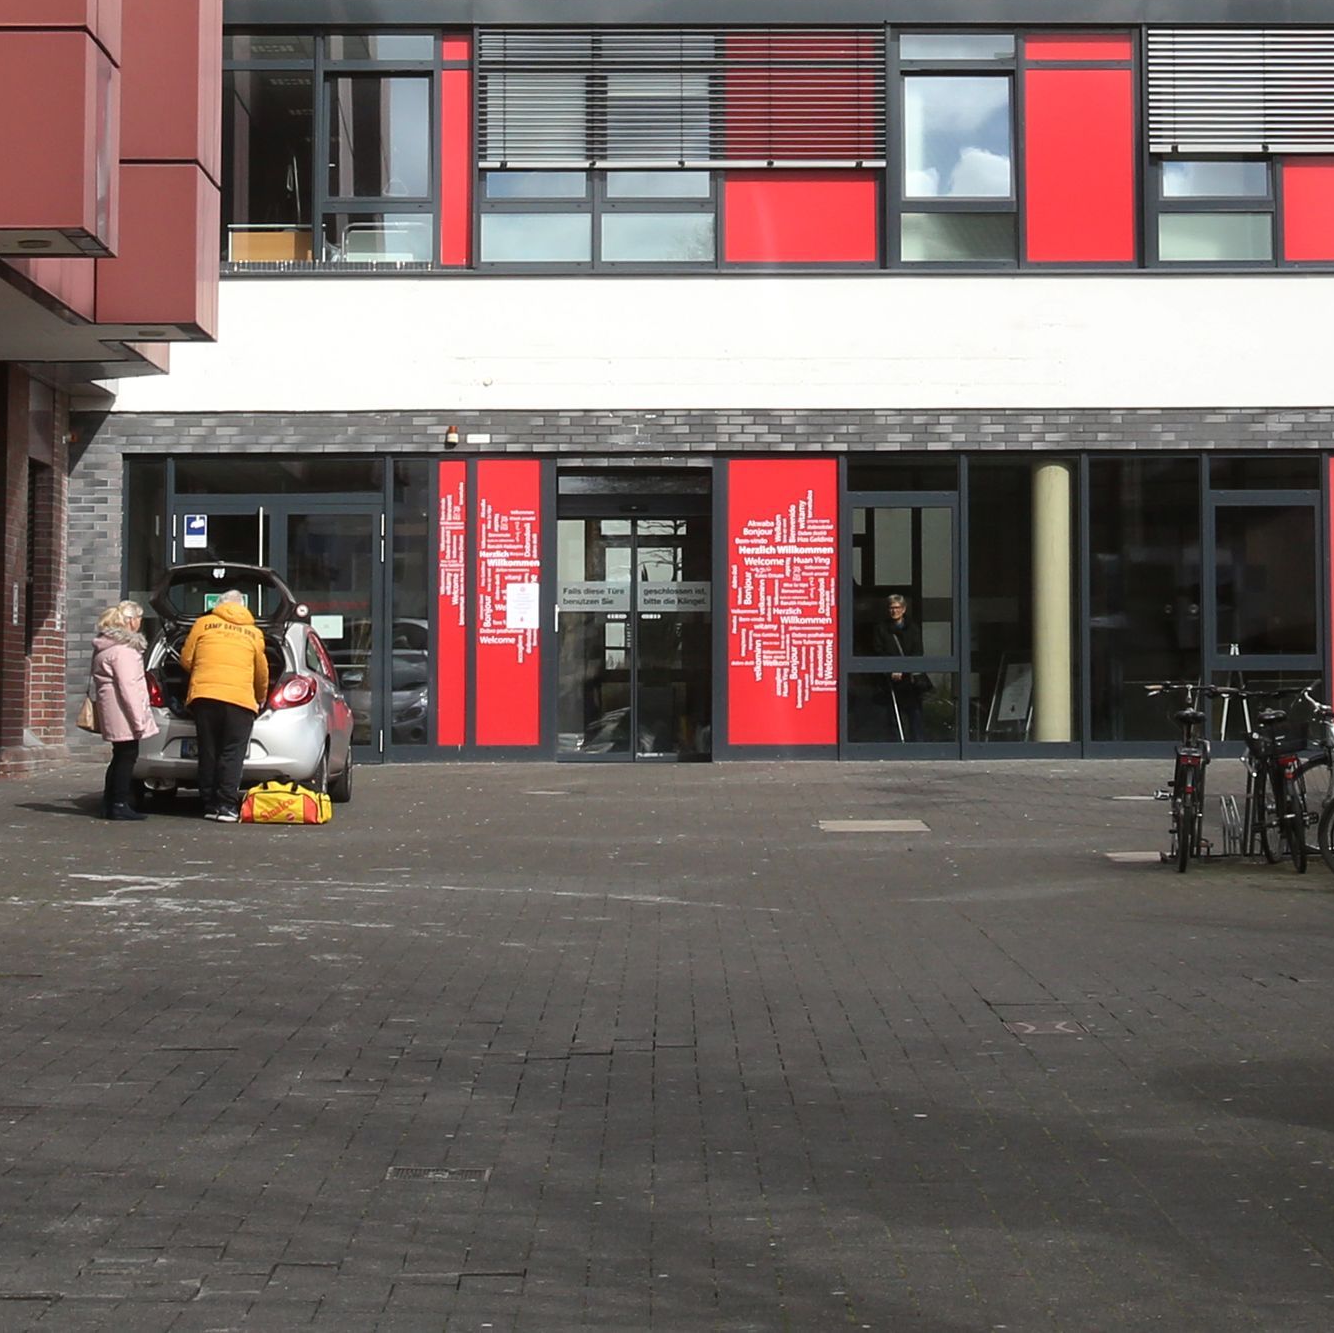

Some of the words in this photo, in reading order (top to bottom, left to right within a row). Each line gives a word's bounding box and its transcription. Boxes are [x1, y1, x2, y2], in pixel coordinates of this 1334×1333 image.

[743, 528, 773, 537] Bonjour
[479, 550, 510, 558] Herzlich
[739, 545, 776, 554] Herzlich
[777, 545, 834, 554] Willkommen
[487, 558, 540, 567] Willkommen
[744, 557, 785, 566] Welcome
[563, 587, 581, 595] Falls
[583, 587, 604, 595] diese
[643, 587, 693, 596] geschlossen
[744, 571, 753, 605] Bonjour
[483, 595, 493, 627] Bonjour
[773, 607, 802, 615] Herzlich
[780, 616, 832, 624] Willkommen
[480, 636, 515, 644] Welcome
[789, 646, 799, 680] Bonjour
[824, 639, 833, 680] Welcome
